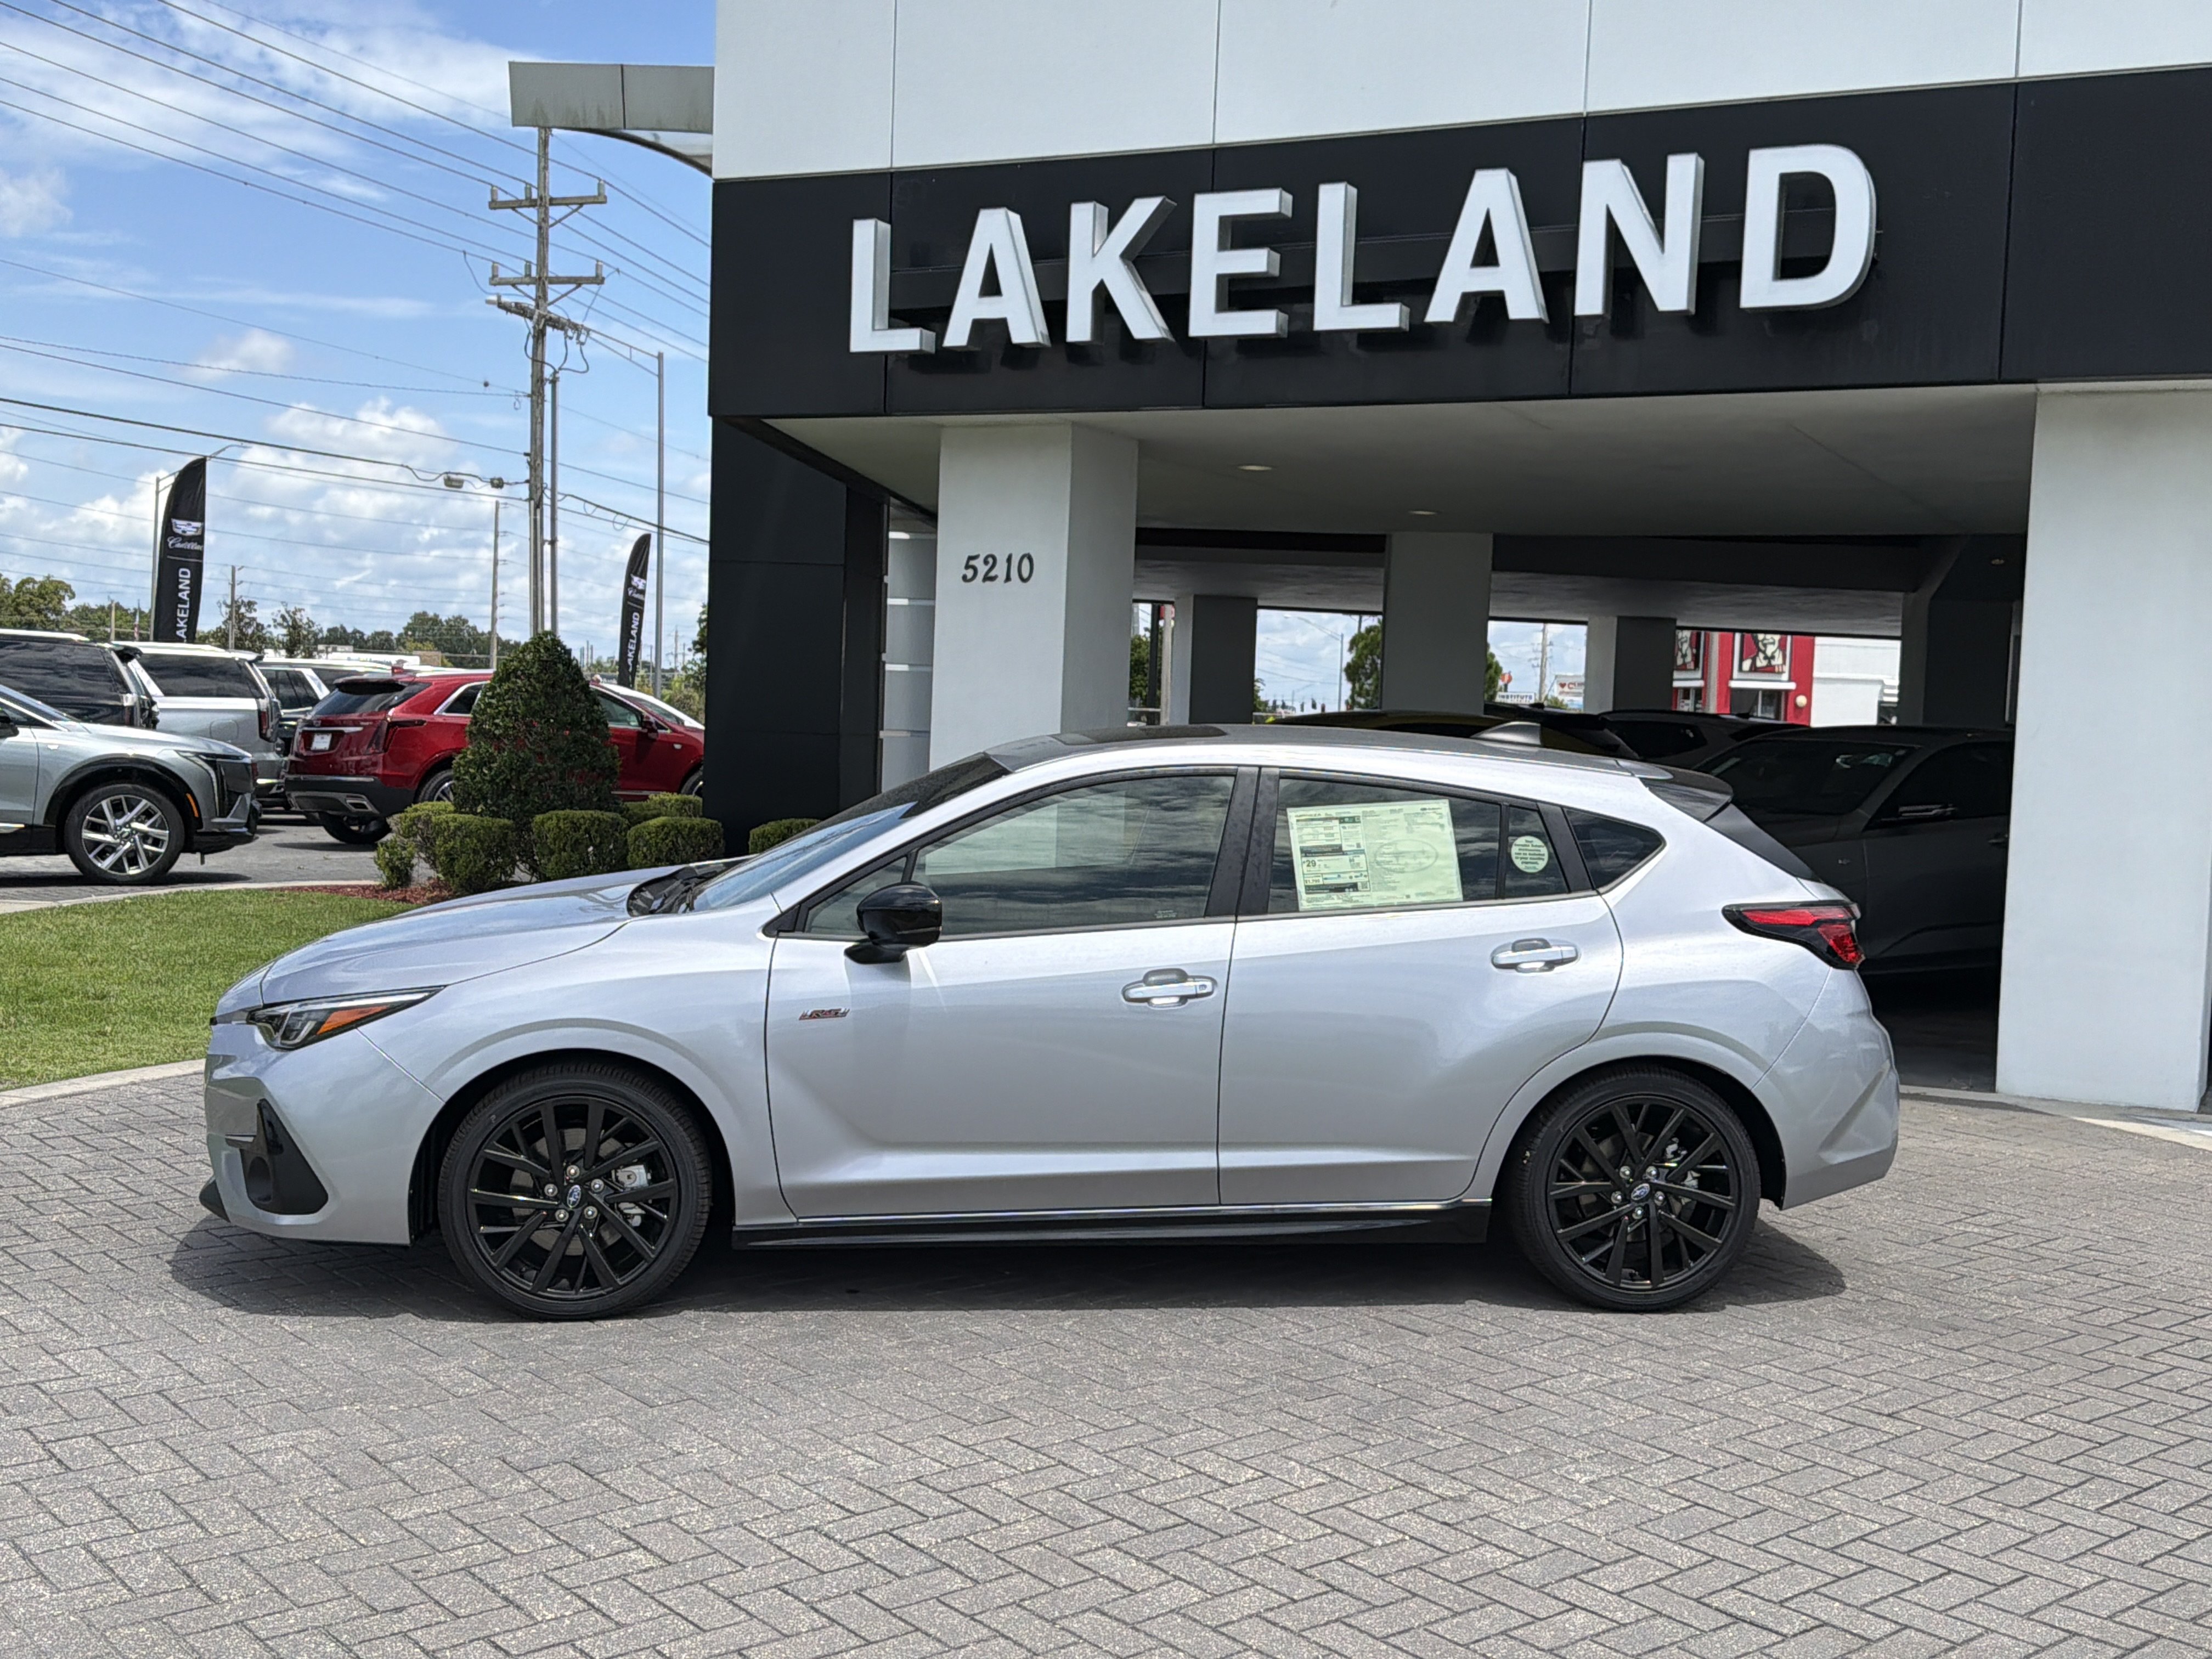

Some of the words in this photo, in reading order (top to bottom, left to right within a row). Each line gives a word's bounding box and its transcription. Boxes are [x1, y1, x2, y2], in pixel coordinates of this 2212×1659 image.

[850, 144, 1876, 354] LAKELAND
[962, 552, 1034, 583] 5210
[176, 568, 191, 643] AKELAND
